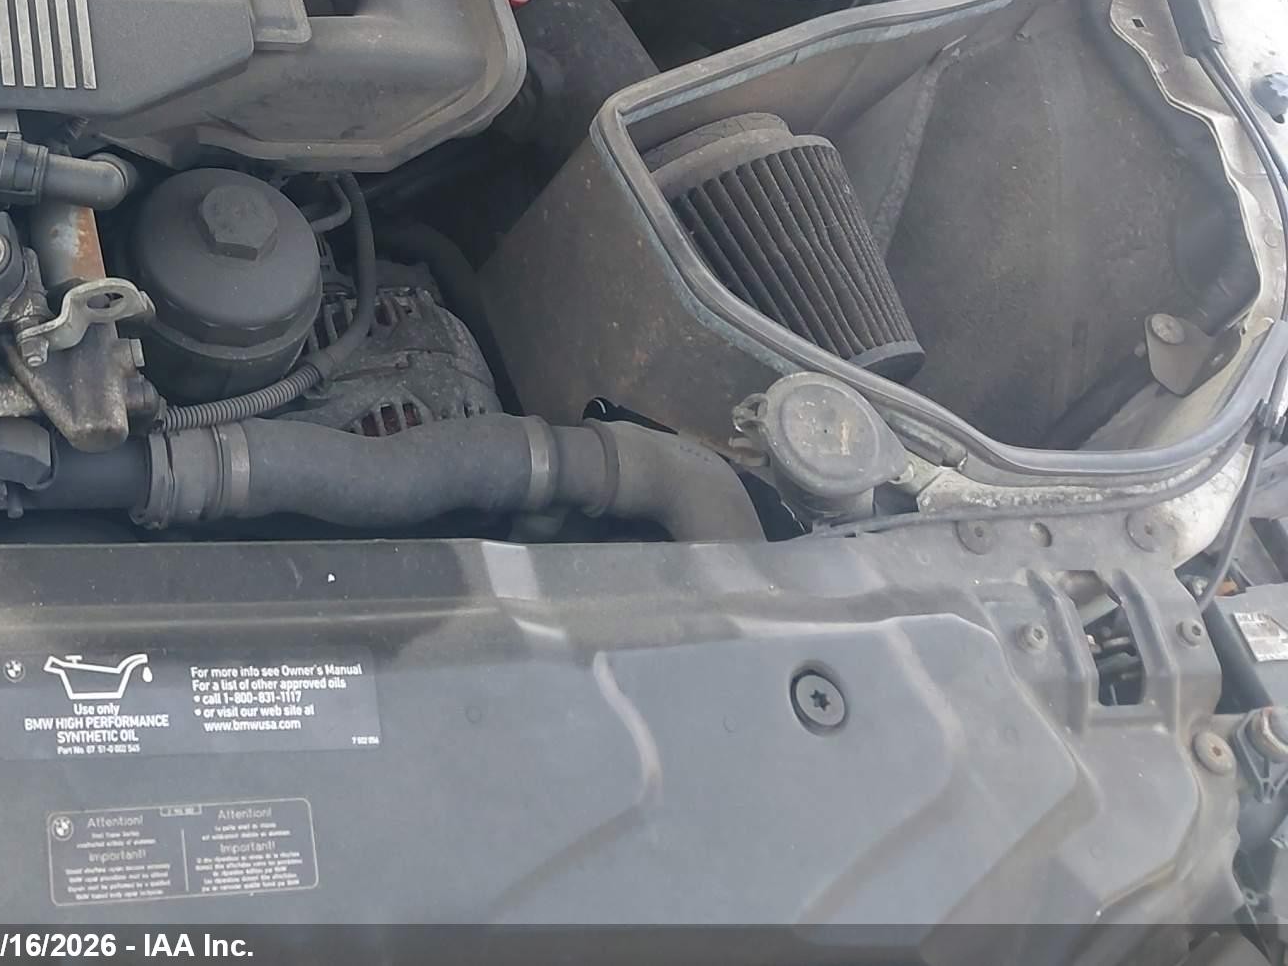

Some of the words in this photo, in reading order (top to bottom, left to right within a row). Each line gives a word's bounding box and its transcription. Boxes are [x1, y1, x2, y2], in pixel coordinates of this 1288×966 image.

[190, 667, 208, 678] For
[211, 668, 238, 678] more
[240, 666, 260, 677] info
[261, 667, 279, 677] see
[281, 665, 323, 676] Owner's
[324, 664, 362, 675] Manual
[192, 680, 209, 692] For
[212, 682, 219, 691] a
[221, 679, 239, 691] list
[240, 679, 250, 690] of
[251, 679, 278, 690] other
[280, 678, 327, 691] approved
[328, 677, 346, 689] oils
[202, 693, 221, 705] call
[223, 691, 302, 704] 1-800-831-1117
[73, 703, 94, 715] Use
[97, 703, 120, 716] only
[203, 708, 217, 718] or
[217, 706, 238, 717] visit
[240, 707, 258, 717] our
[260, 705, 281, 716] web
[284, 705, 302, 715] site
[304, 704, 314, 715] at
[24, 718, 53, 730] BMW
[55, 717, 83, 729] HIGH
[85, 714, 169, 729] PERFORMANCE
[204, 720, 301, 732] www.bmwusa.com
[57, 731, 118, 743] SYNTHETIC
[120, 729, 139, 741] OIL
[218, 807, 272, 819] Attention!
[87, 815, 143, 828] Attention!
[220, 841, 276, 854] Important!
[89, 849, 146, 864] Important!
